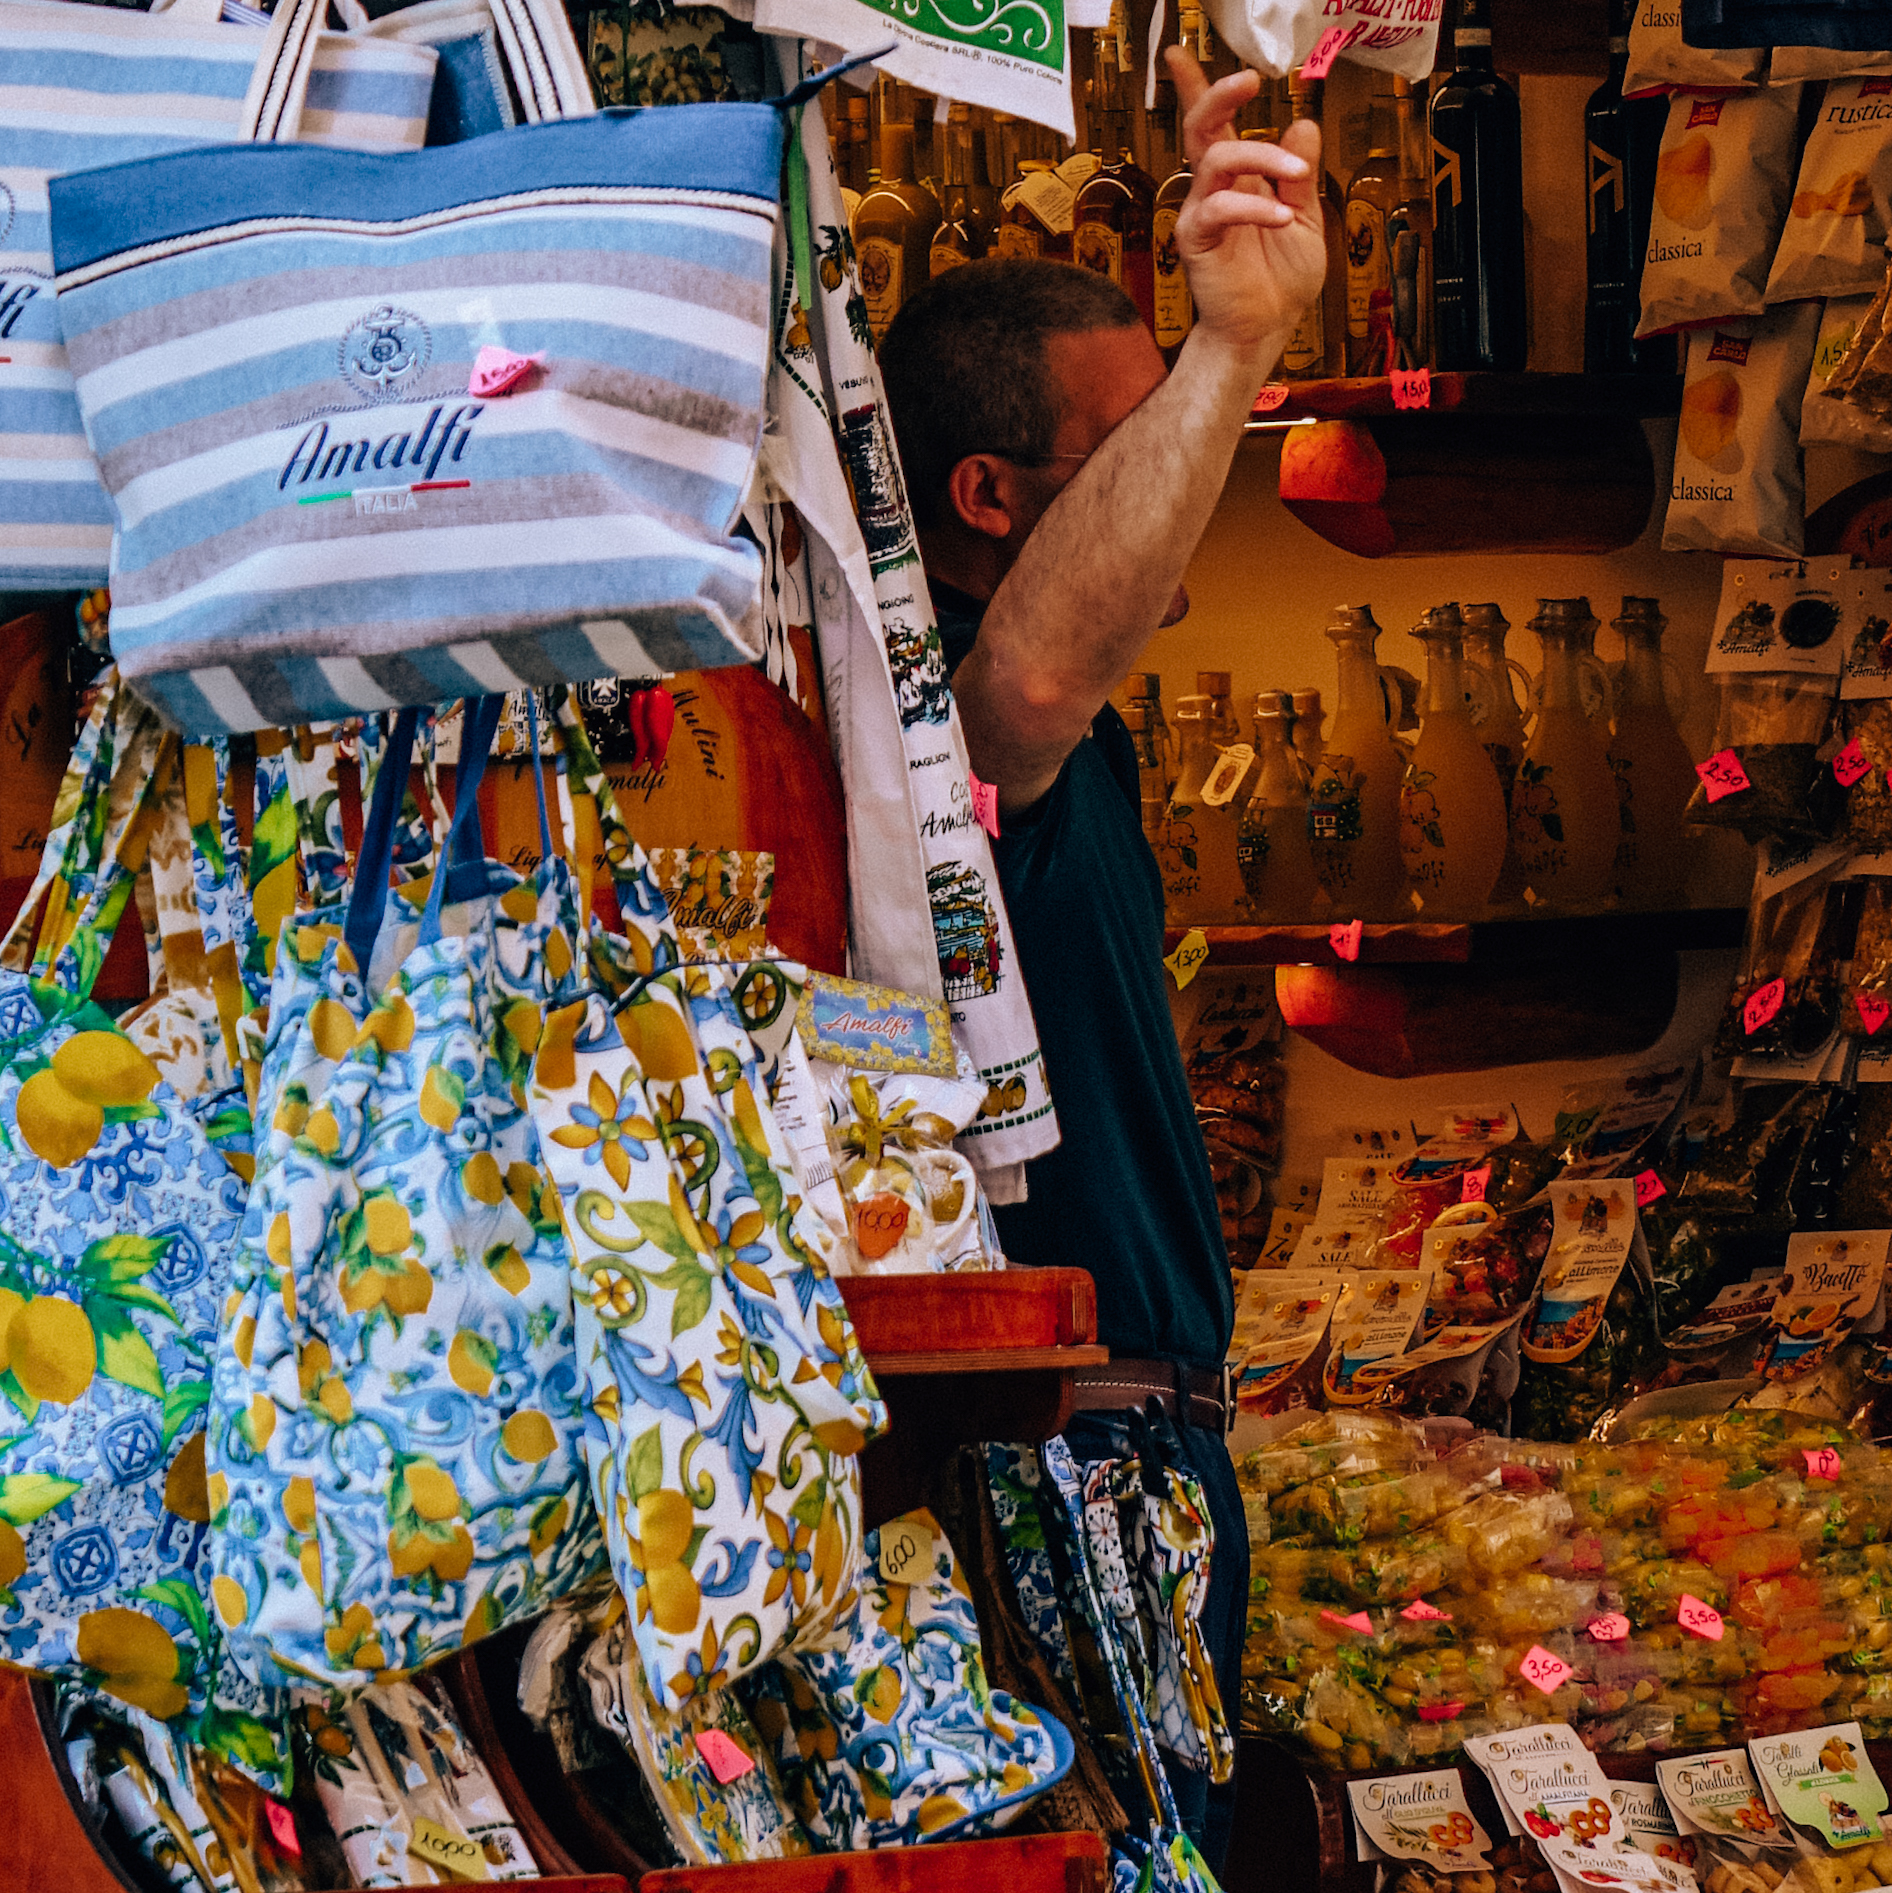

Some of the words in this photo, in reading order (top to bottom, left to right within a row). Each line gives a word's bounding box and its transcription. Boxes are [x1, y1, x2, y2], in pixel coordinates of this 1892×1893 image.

[986, 55, 1011, 69] 100%
[1648, 238, 1704, 266] classica
[1713, 348, 1746, 361] CARLO
[278, 404, 485, 491] Amalfi
[354, 492, 418, 516] ITALIA
[1671, 480, 1736, 504] classica
[1704, 760, 1743, 786] 2,50
[822, 1012, 912, 1039] Amalfi
[1348, 1189, 1382, 1203] SALE
[1685, 1609, 1718, 1626] 3,50
[1528, 1659, 1563, 1681] 3,50
[1488, 1734, 1573, 1760] Tarallucci
[1508, 1768, 1590, 1792] Tarallucci
[1677, 1767, 1747, 1795] Tarallucci
[1364, 1780, 1453, 1812] Tarallucci
